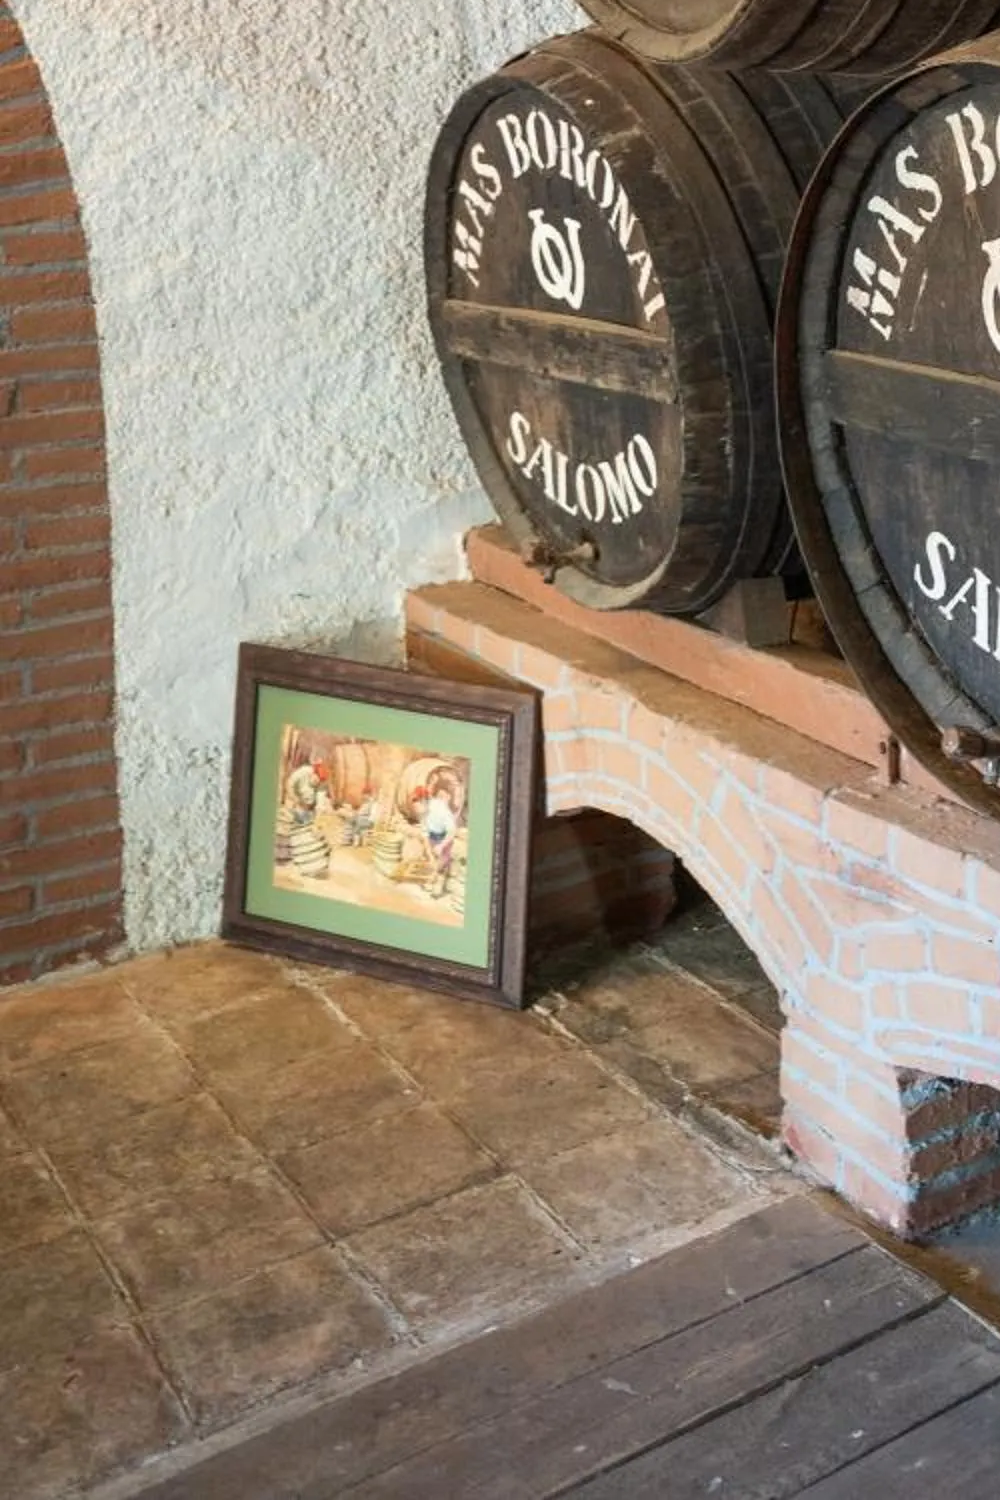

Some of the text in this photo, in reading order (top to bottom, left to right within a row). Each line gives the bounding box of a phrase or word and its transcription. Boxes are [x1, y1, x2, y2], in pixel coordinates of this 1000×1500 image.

[453, 144, 502, 287] MAS
[845, 145, 944, 342] MAS
[504, 410, 659, 526] SALOMO
